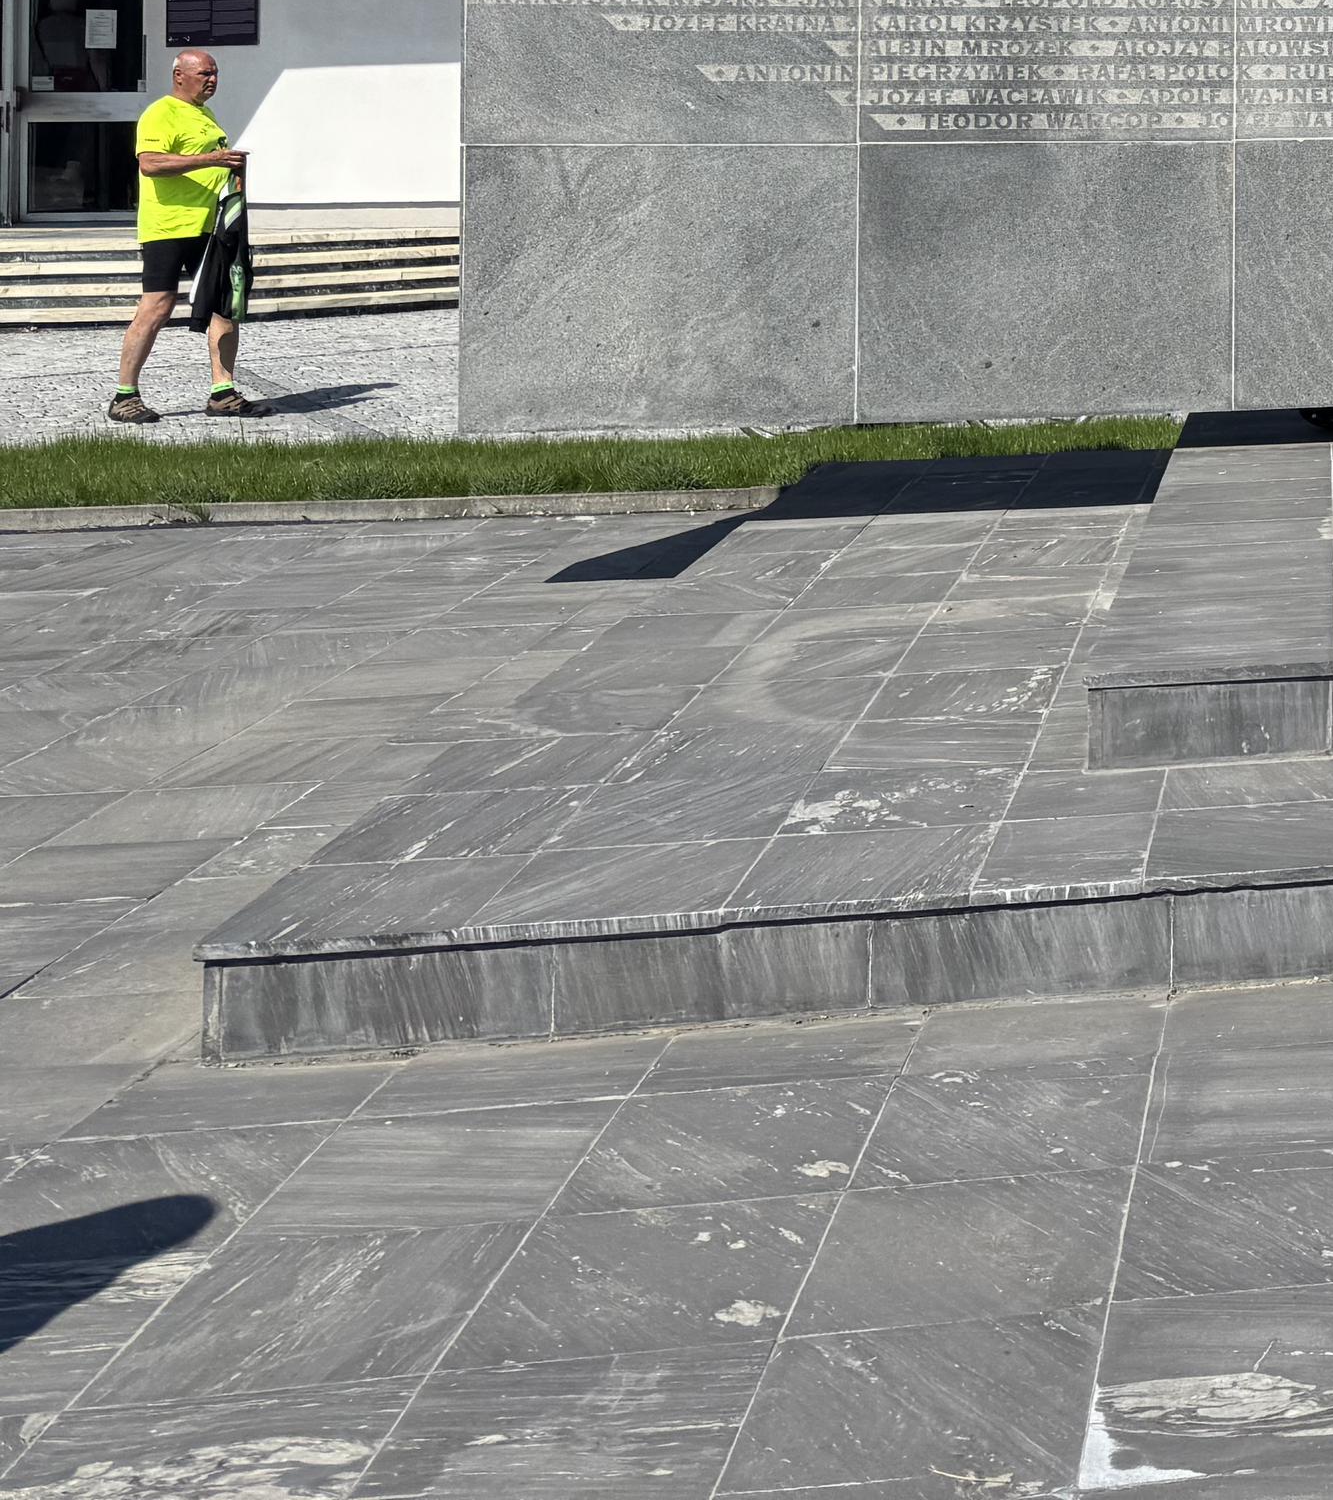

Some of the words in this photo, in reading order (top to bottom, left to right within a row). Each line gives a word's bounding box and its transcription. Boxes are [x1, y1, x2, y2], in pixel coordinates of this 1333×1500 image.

[642, 14, 726, 32] JOZEF
[736, 14, 834, 32] KRAINA
[869, 15, 957, 32] KAROL
[964, 15, 1100, 32] KRZYSTEK
[1128, 15, 1223, 32] ANTONI
[866, 40, 946, 57] ALBIN
[961, 40, 1073, 57] MROZEK
[1113, 40, 1207, 56] ALOJZY
[735, 64, 853, 82] ANTONIN
[869, 63, 1042, 82] PIEGRZYMEK
[1164, 63, 1252, 80] POLOK
[869, 89, 954, 106] JOZEF
[1139, 87, 1222, 104] ADOLF
[921, 113, 1033, 130] TEODOR
